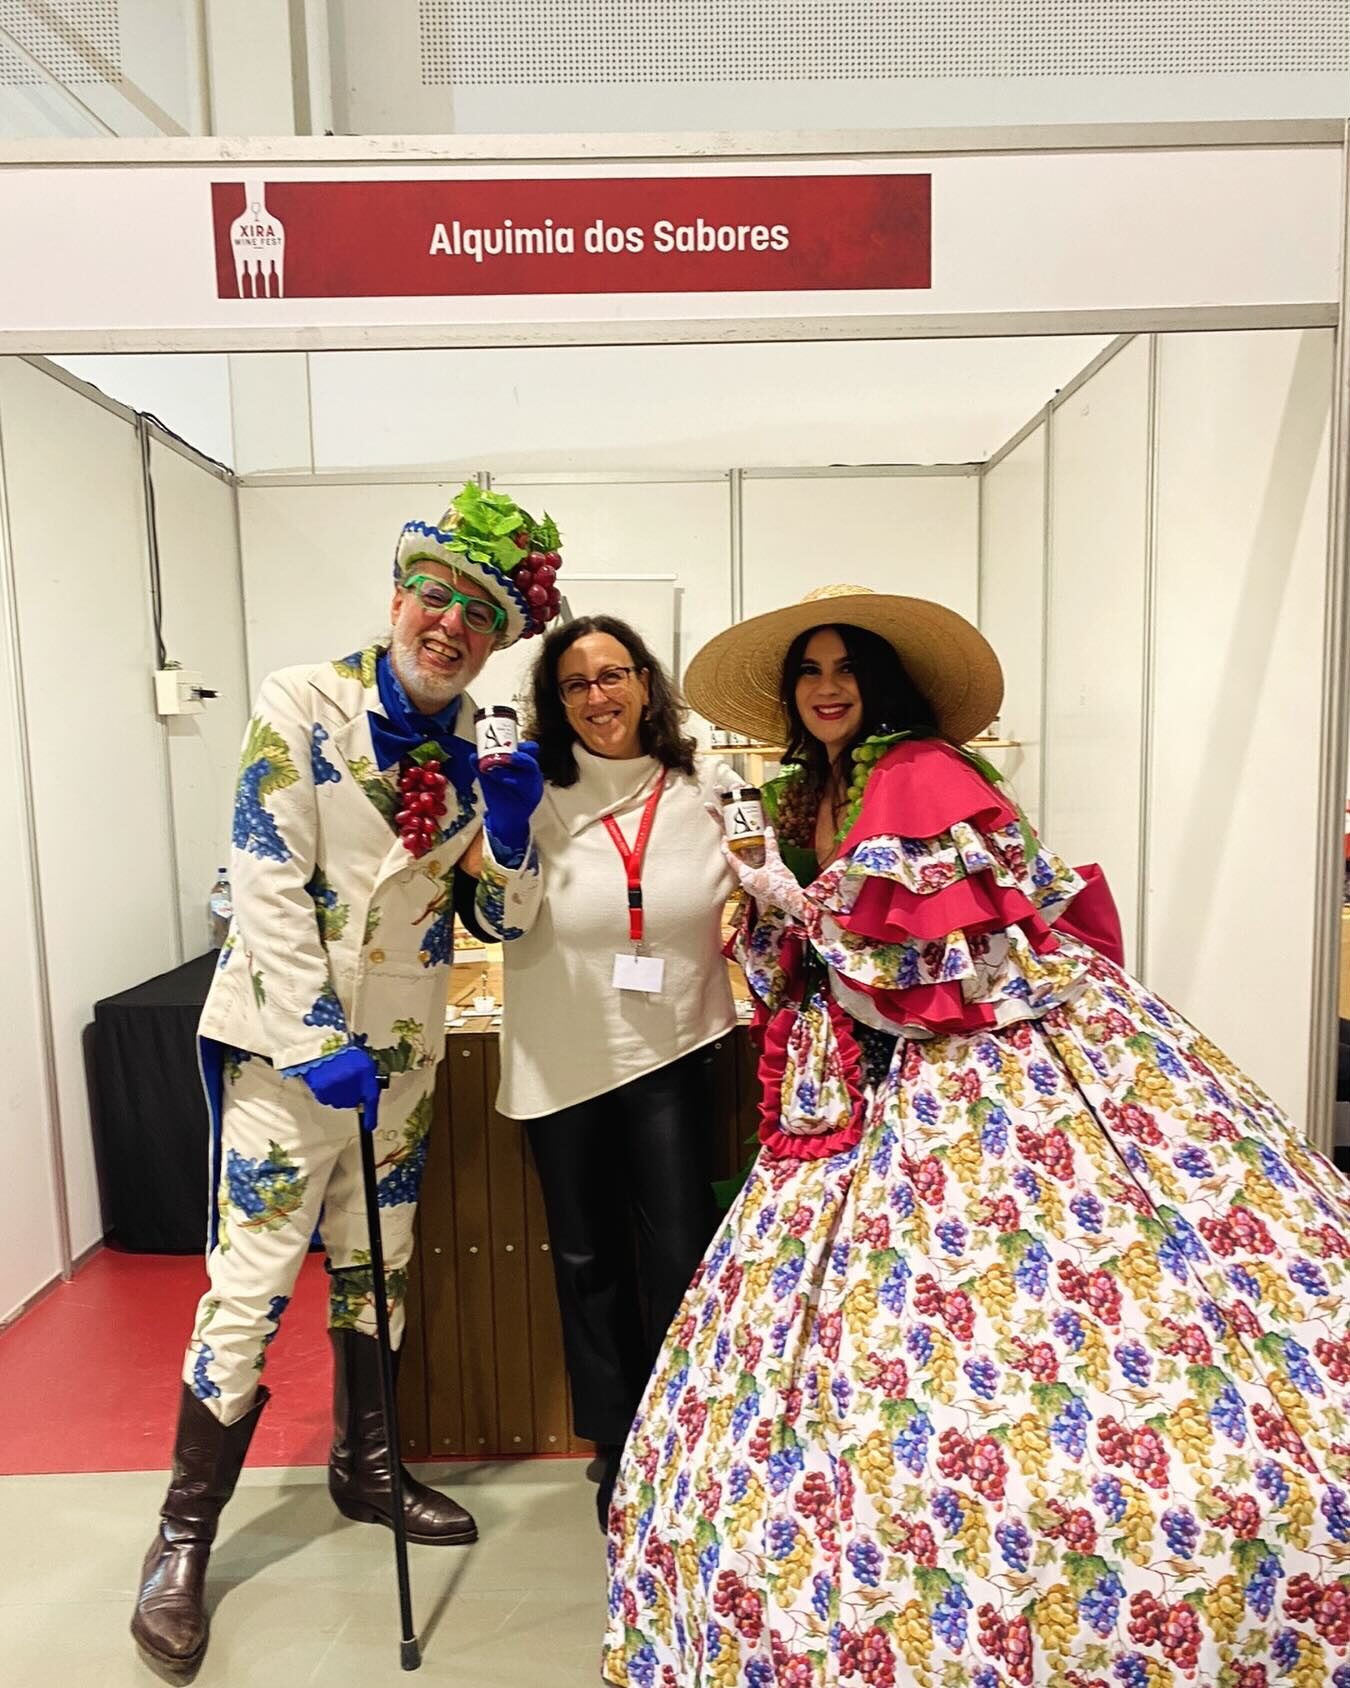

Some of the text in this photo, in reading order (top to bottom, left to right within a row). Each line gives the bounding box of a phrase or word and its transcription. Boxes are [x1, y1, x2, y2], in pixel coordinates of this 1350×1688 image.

[240, 225, 275, 238] XIRA
[234, 238, 282, 246] WINE FEST
[429, 218, 790, 263] Alquimia dos Sabores
